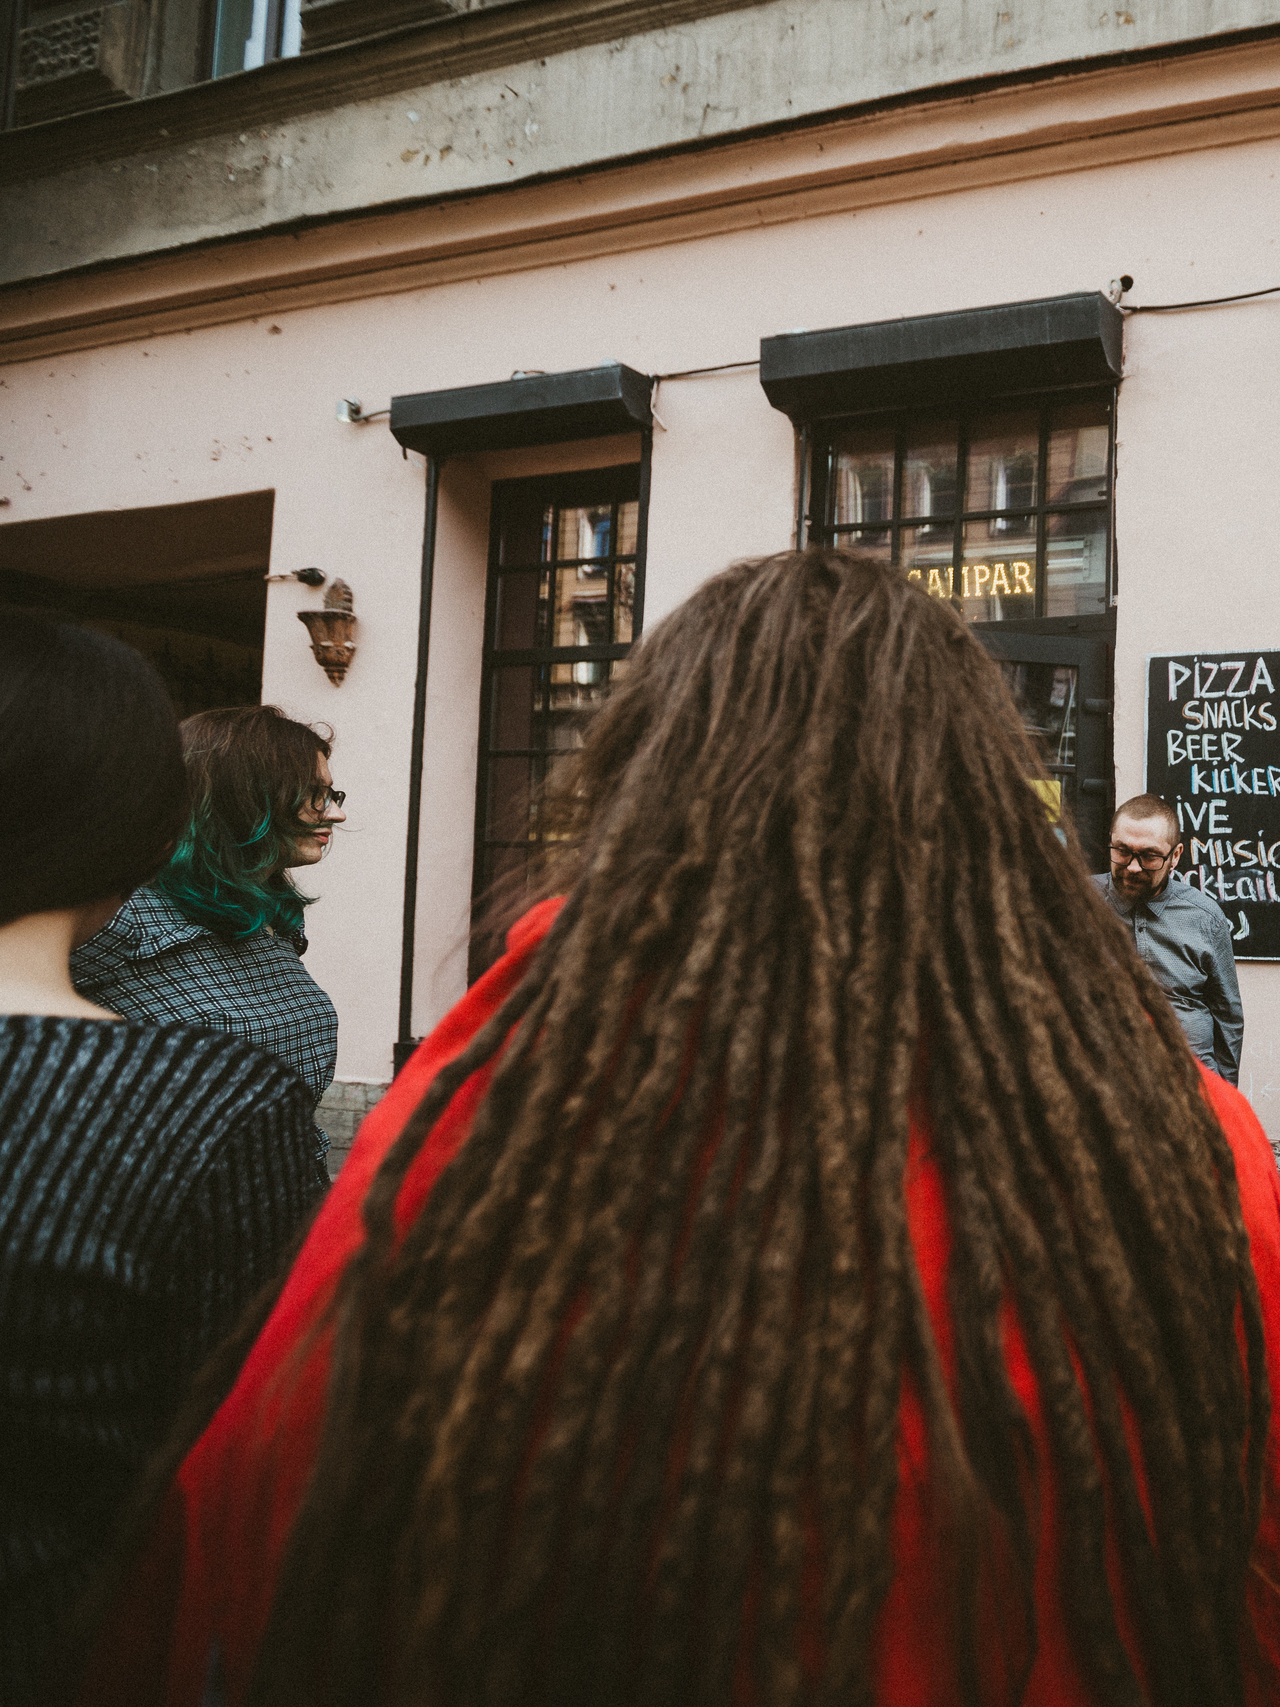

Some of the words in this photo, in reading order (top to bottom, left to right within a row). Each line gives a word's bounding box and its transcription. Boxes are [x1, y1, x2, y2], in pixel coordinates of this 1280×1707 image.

[1182, 698, 1278, 731] SNACKS
[1167, 729, 1246, 767] BEER
[1160, 795, 1233, 835] iVE
